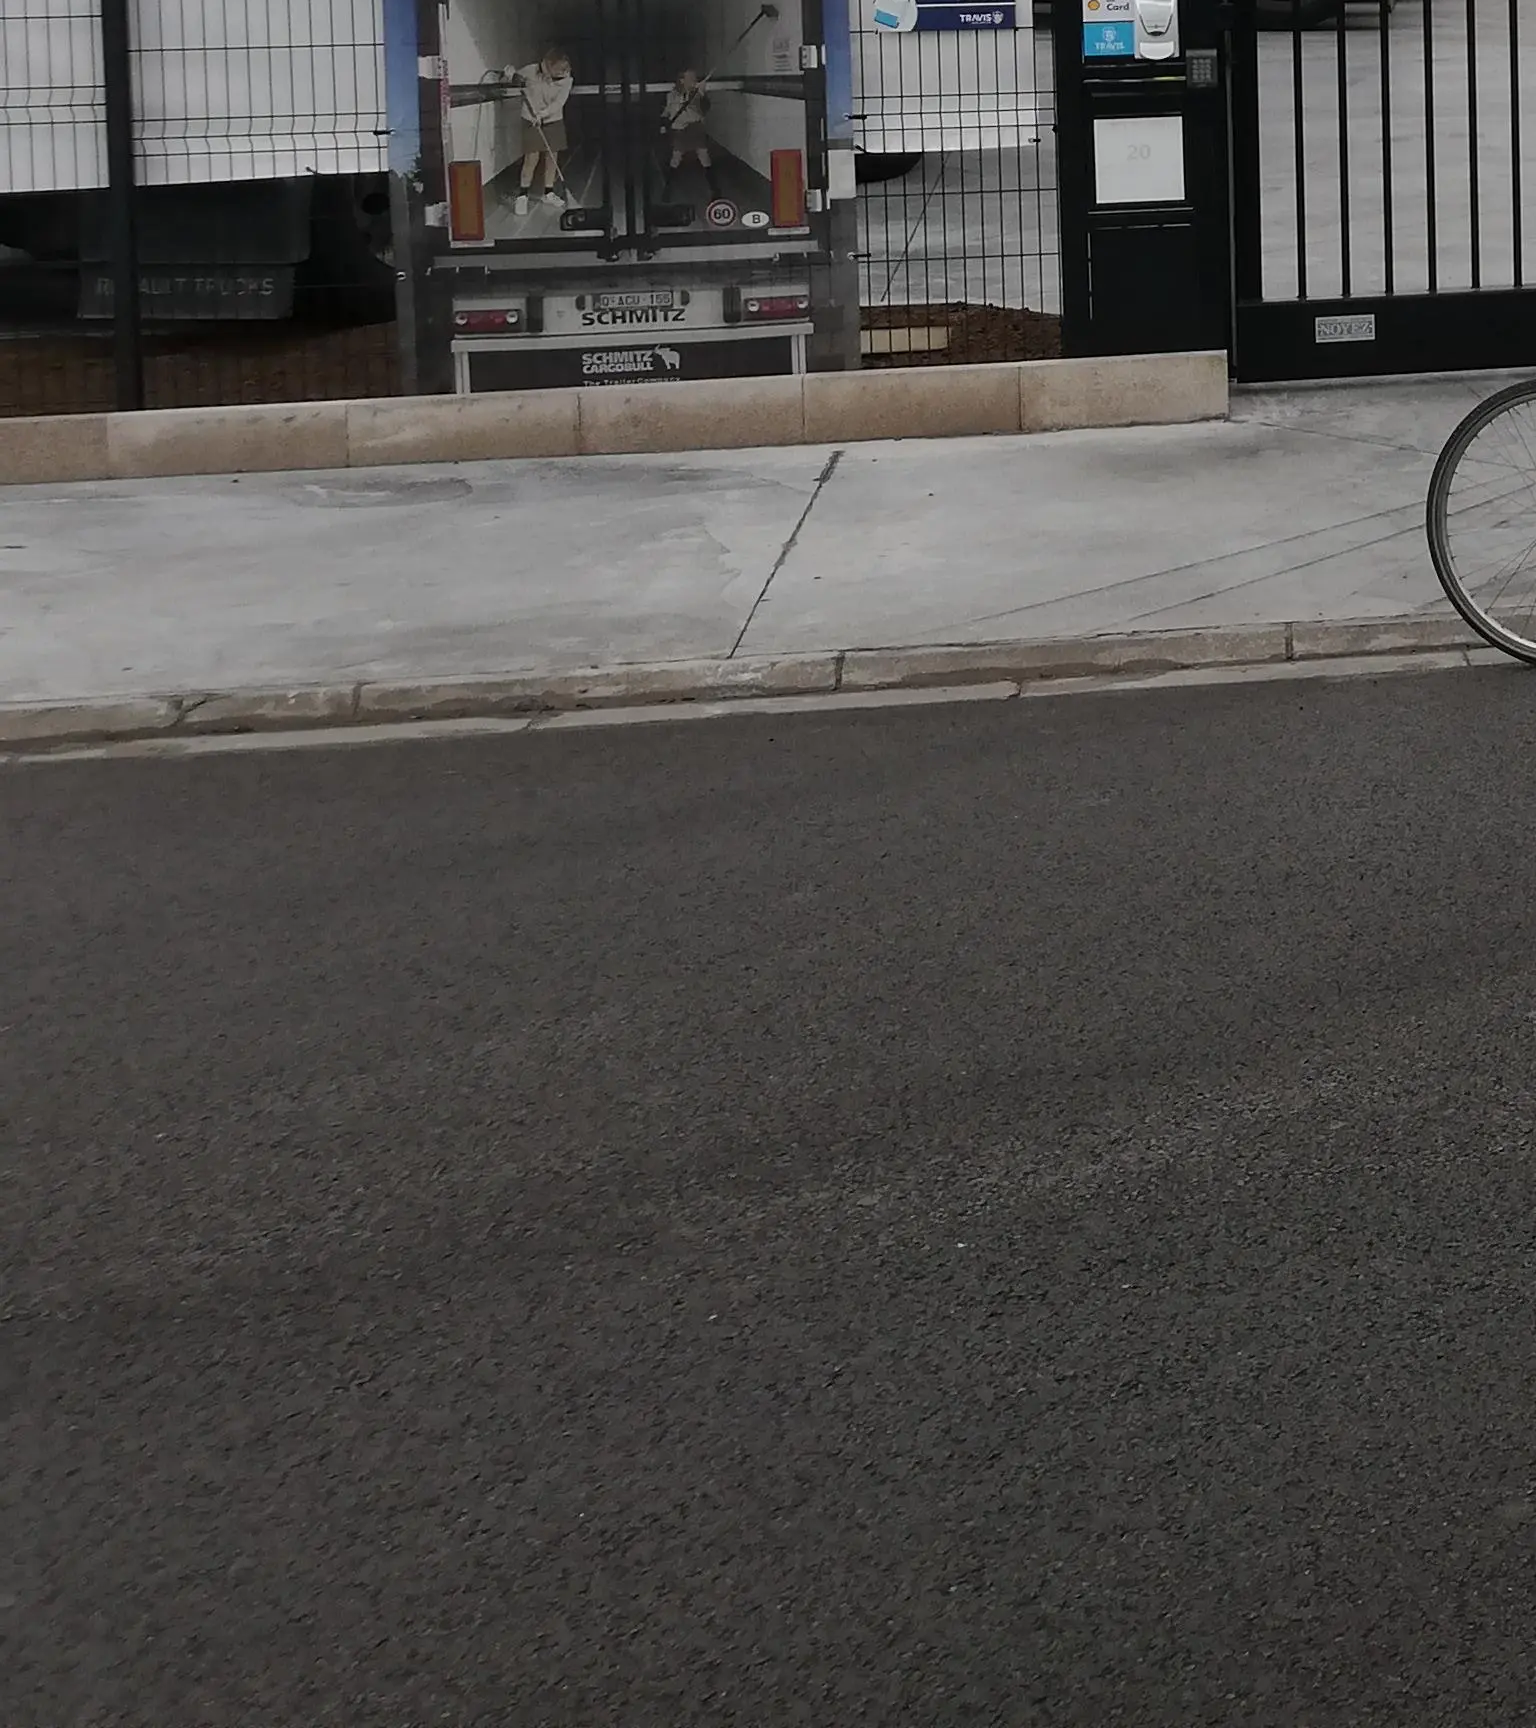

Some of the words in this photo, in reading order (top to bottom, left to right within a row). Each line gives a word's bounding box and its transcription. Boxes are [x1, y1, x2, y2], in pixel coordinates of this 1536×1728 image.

[1107, 3, 1130, 11] Card
[960, 13, 993, 23] TRAVIS
[582, 308, 686, 326] SCHMITZ
[582, 350, 654, 365] SCHMITZ
[582, 361, 654, 374] CARGOBULL
